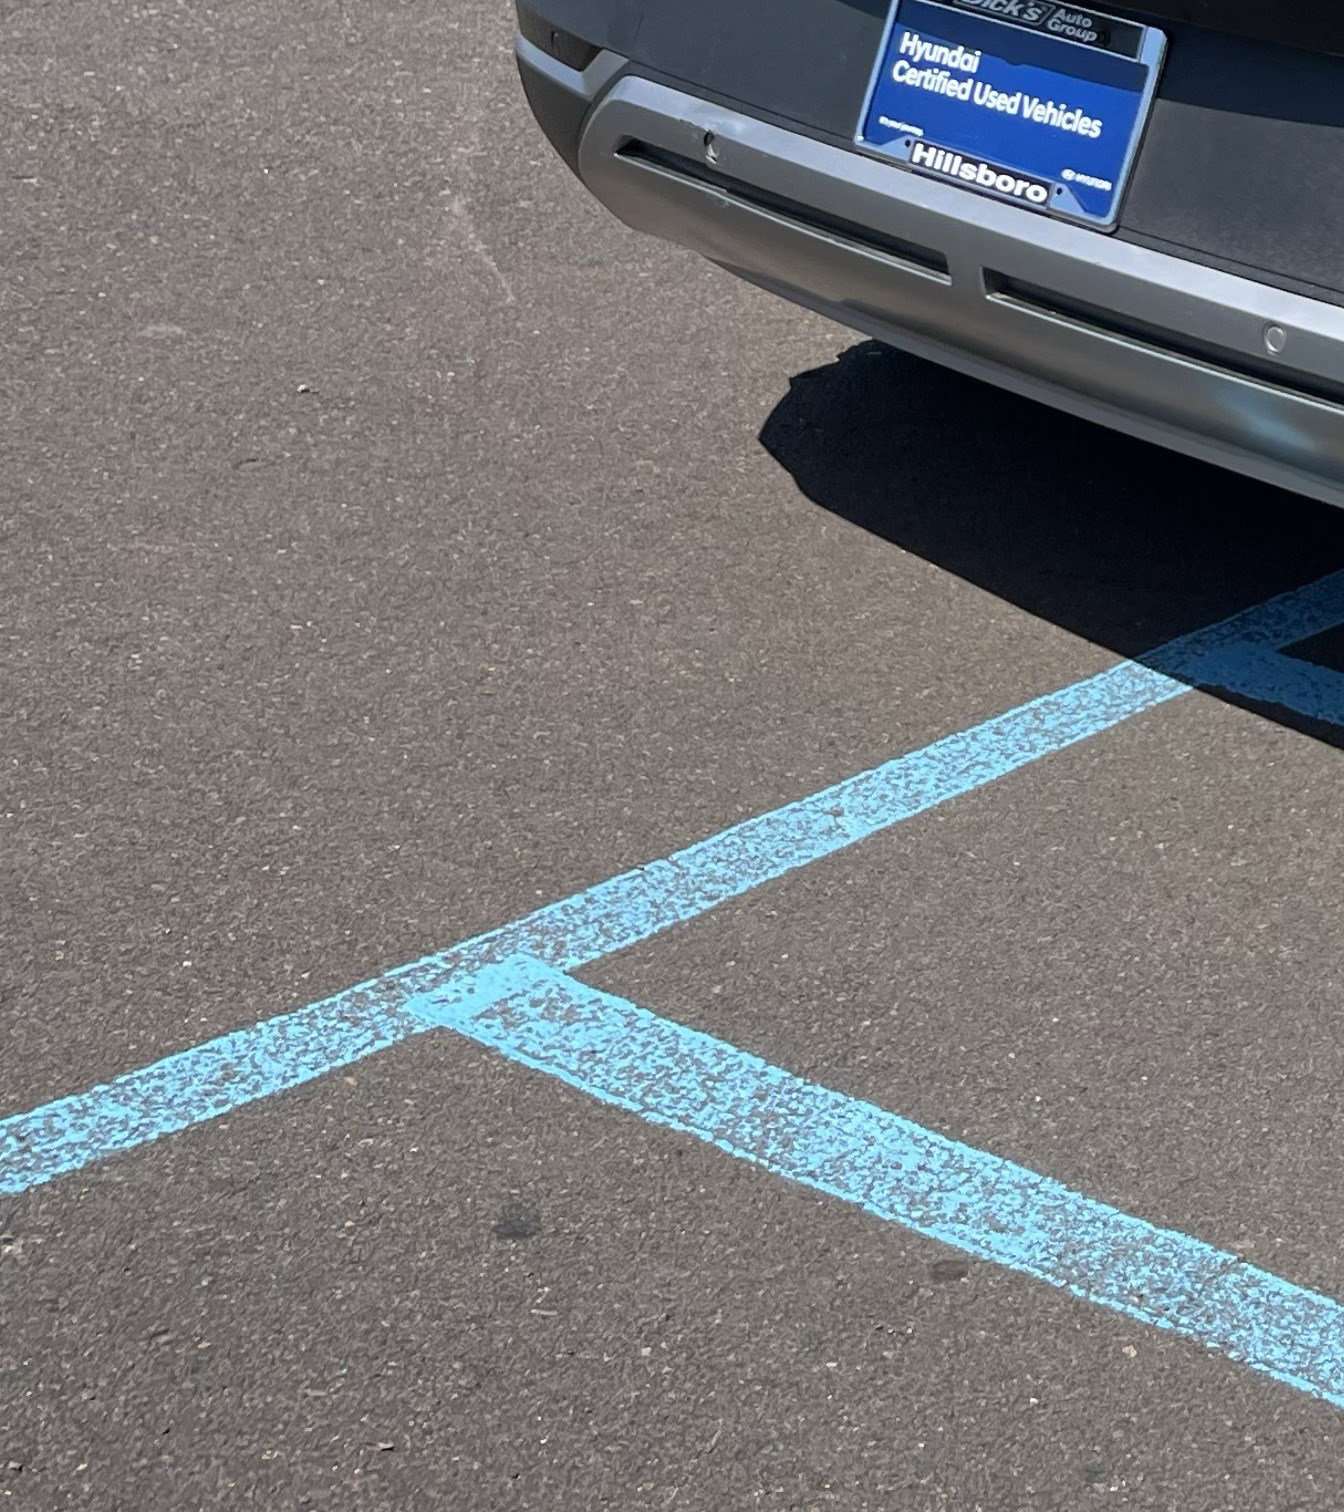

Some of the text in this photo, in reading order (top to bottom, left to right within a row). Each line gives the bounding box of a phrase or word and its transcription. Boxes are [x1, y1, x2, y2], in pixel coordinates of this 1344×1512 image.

[1047, 19, 1098, 43] Group
[1054, 8, 1093, 29] Auto
[899, 31, 982, 73] Hyundai
[892, 60, 1103, 138] Certified Used Vehicles
[912, 143, 1048, 204] Hillsboro
